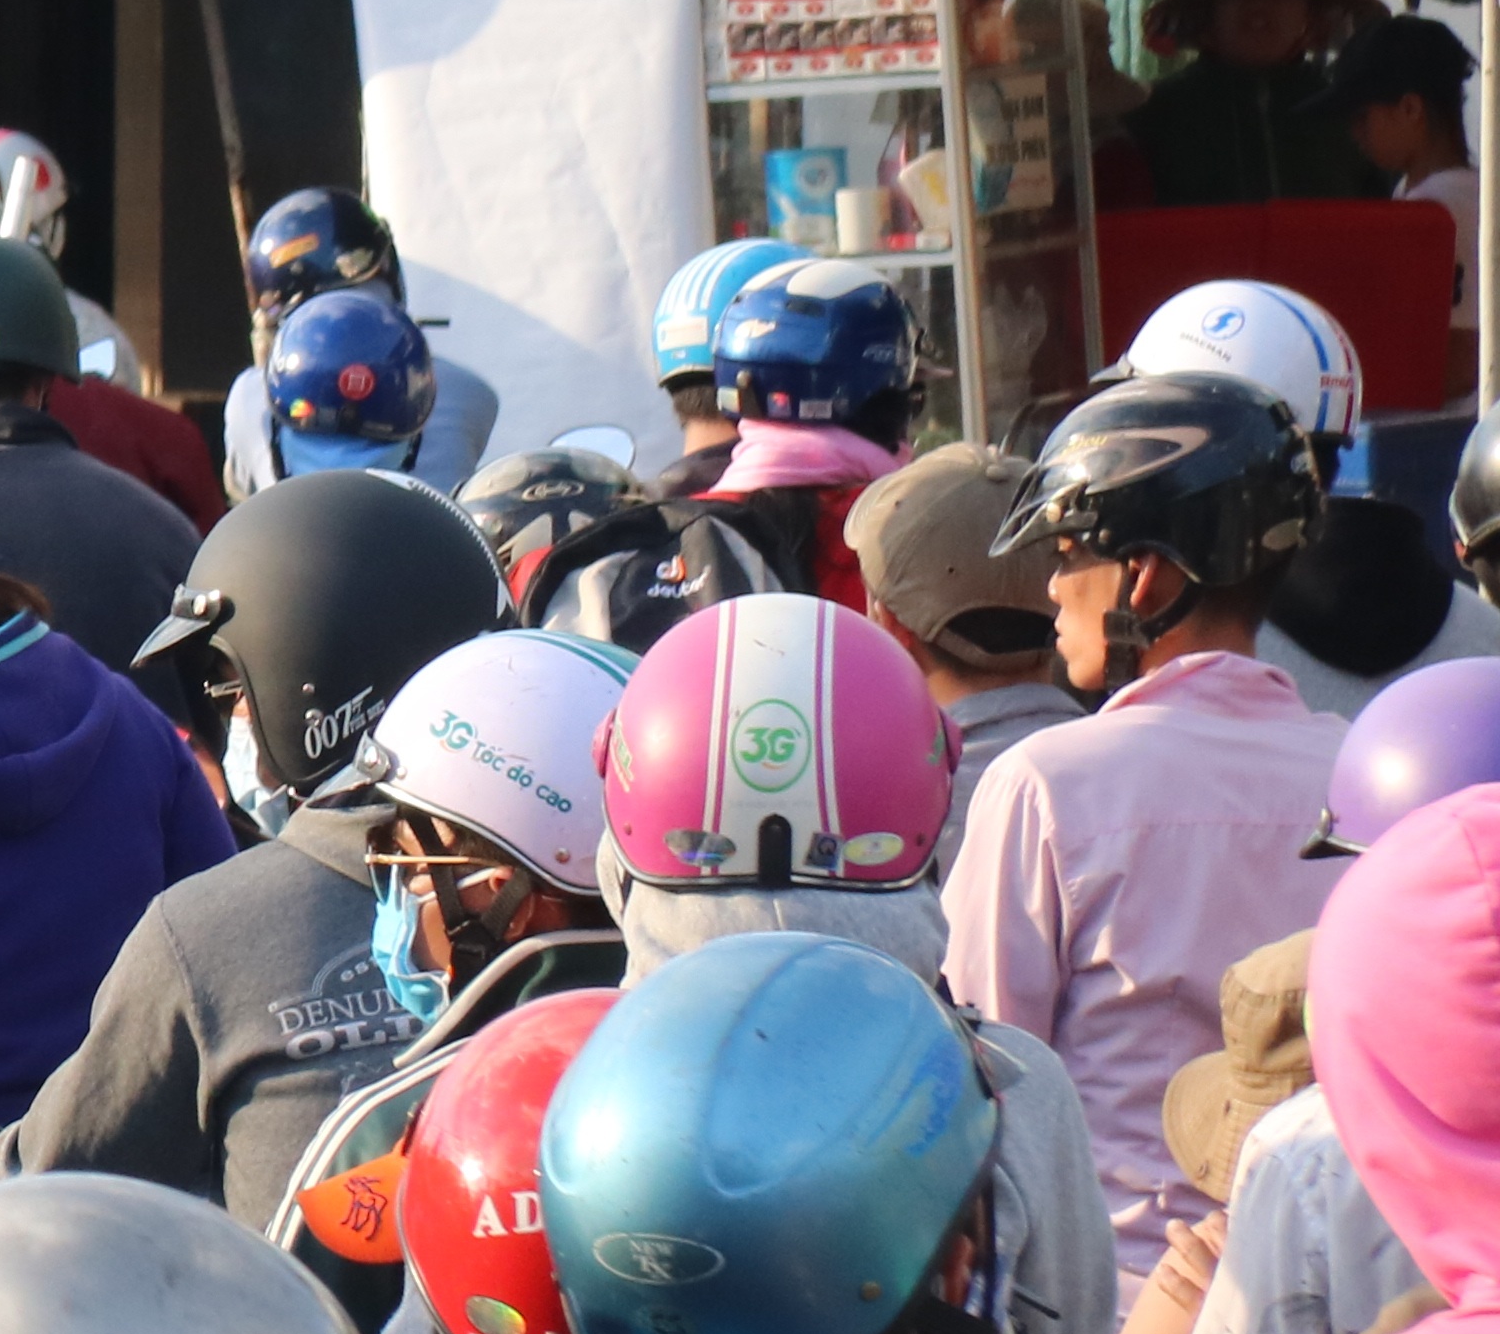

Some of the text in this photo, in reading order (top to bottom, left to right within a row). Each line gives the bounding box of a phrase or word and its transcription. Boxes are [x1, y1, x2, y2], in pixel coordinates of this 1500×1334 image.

[429, 709, 477, 751] 3G
[536, 784, 573, 814] cao
[739, 726, 797, 764] 3G
